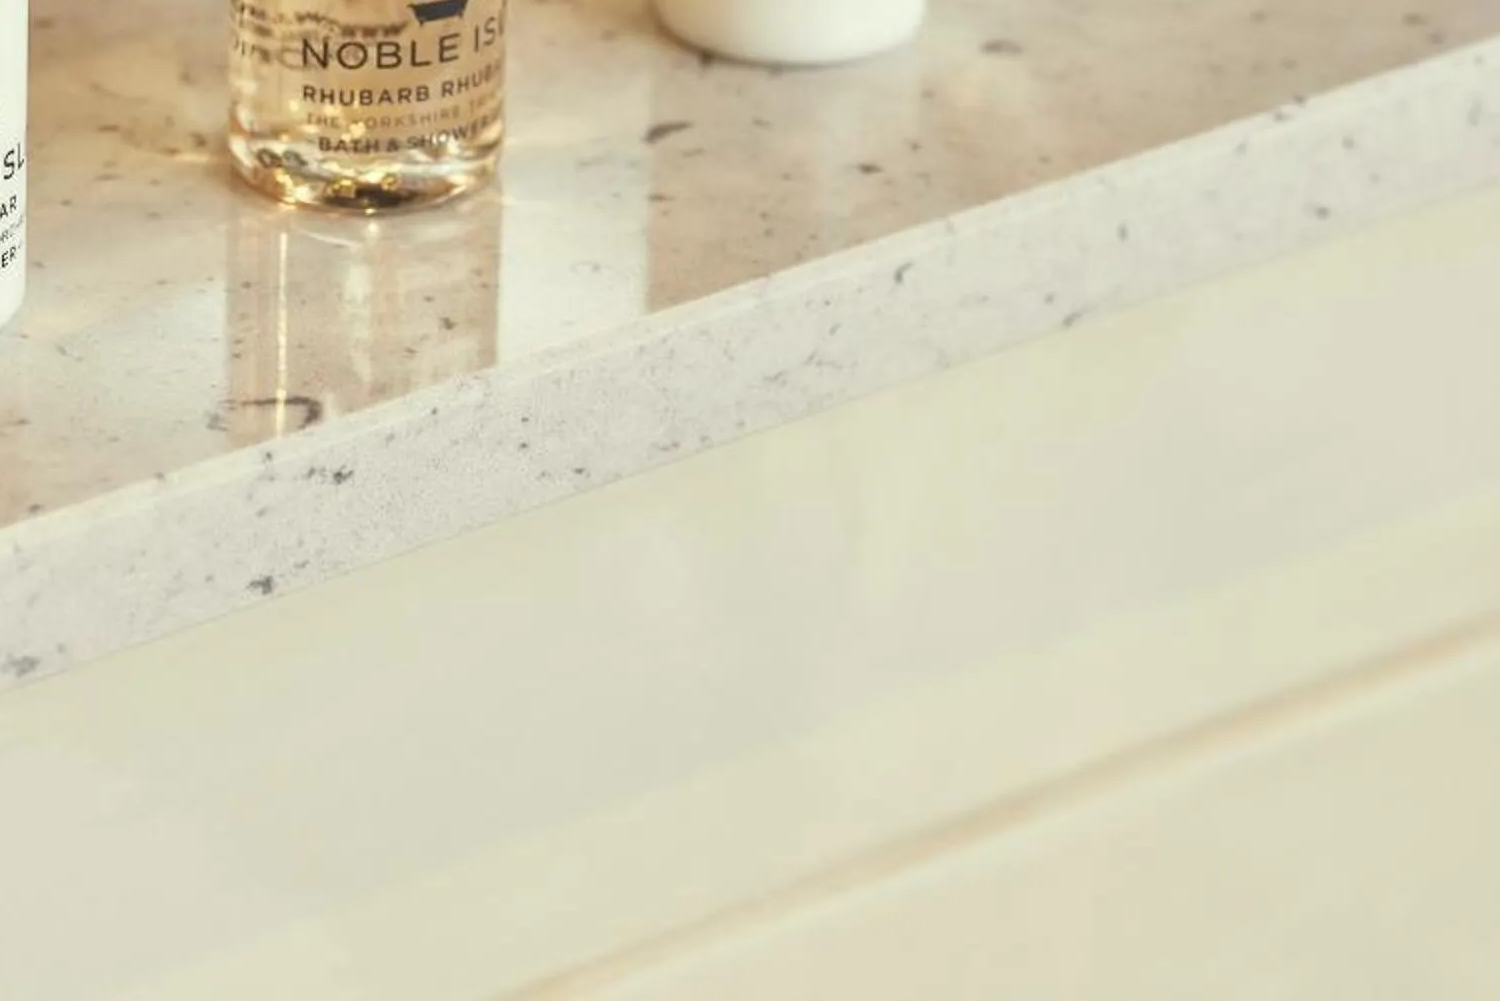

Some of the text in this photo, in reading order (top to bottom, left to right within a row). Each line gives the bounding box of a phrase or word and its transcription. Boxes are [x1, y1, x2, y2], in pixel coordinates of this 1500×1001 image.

[302, 33, 460, 70] NOBLE
[303, 85, 430, 106] RHUBARB
[319, 136, 378, 154] BATH
